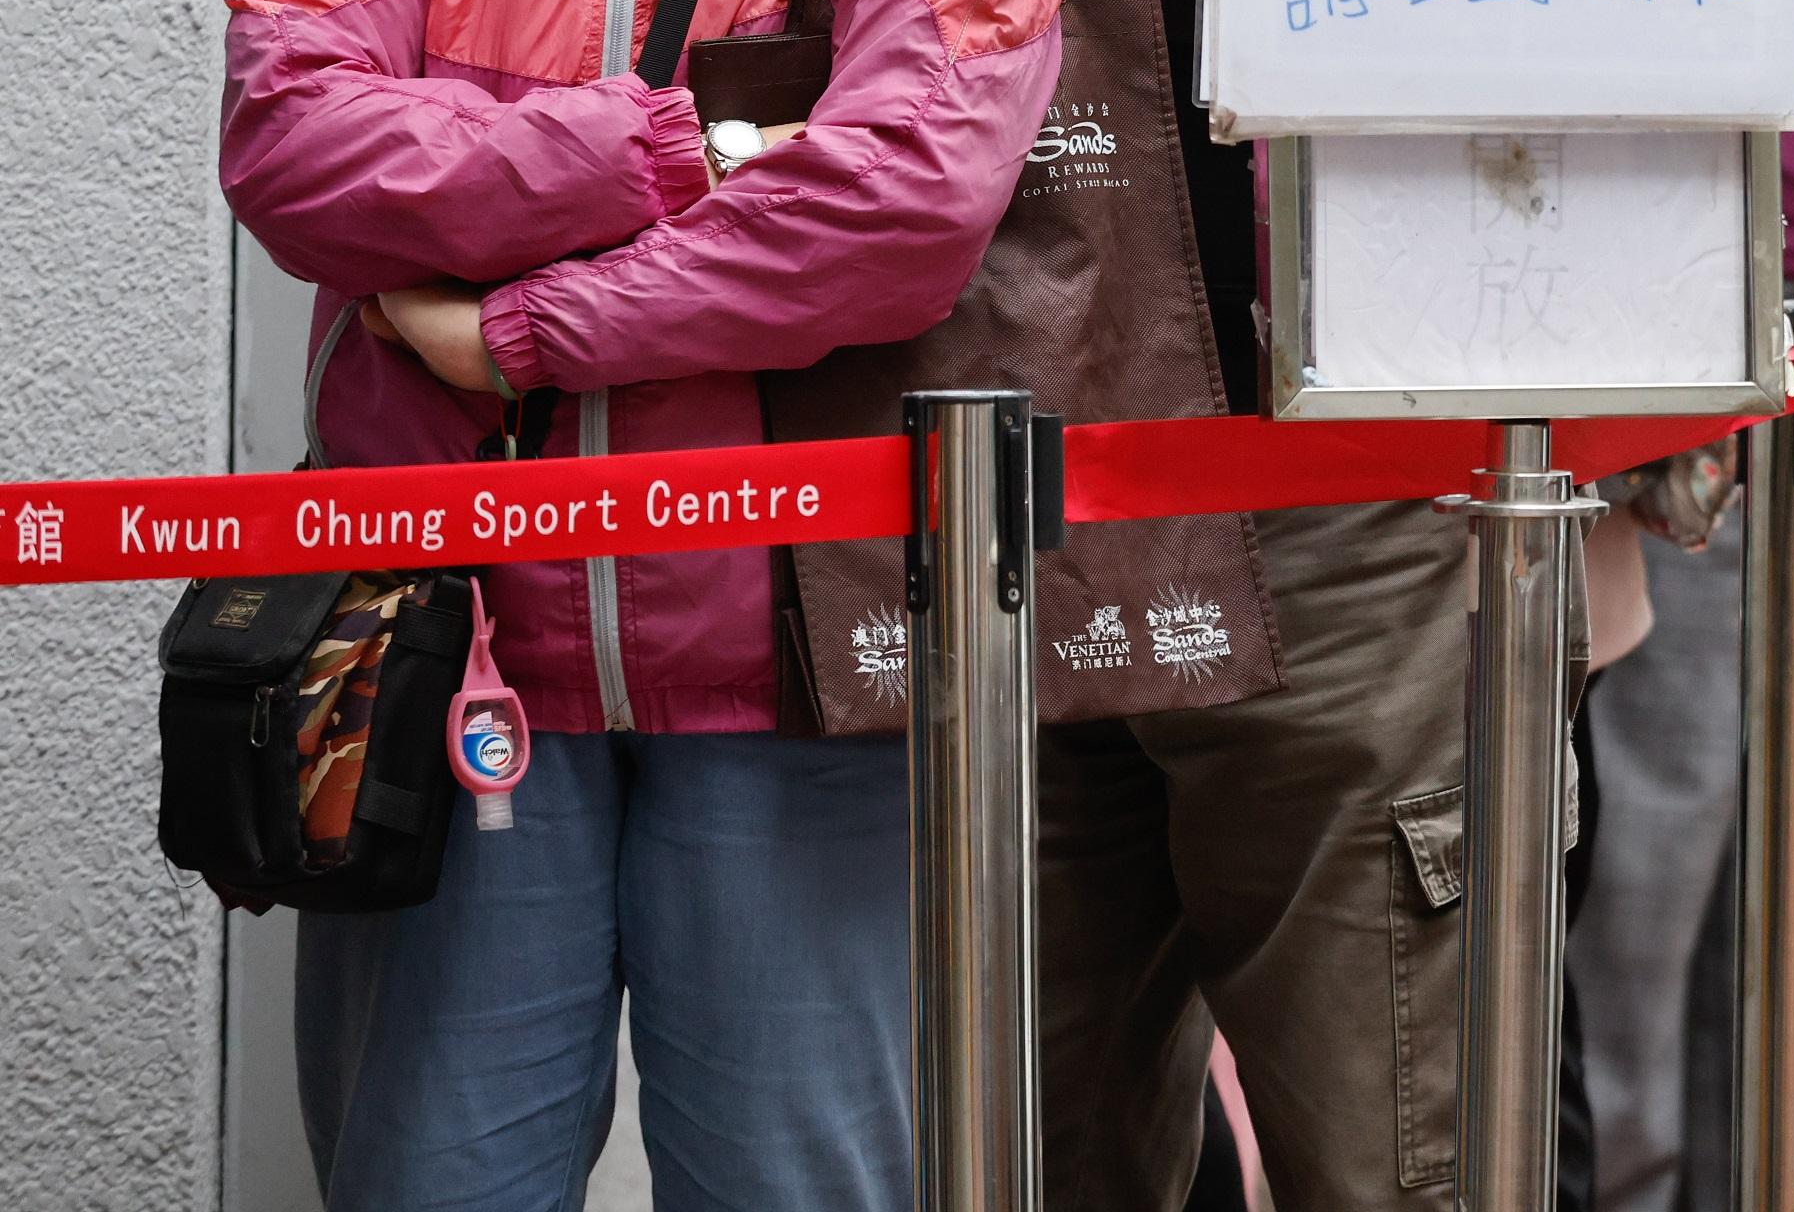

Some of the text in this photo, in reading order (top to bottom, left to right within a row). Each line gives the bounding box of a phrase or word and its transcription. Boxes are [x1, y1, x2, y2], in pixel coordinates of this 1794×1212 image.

[1025, 121, 1118, 164] Sands
[1047, 162, 1110, 179] REWARDS
[1022, 182, 1069, 199] COTAI
[0, 479, 821, 565] 館 Kwun Chung Sport Centre
[1071, 634, 1088, 643] THE
[1152, 623, 1228, 651] Sands
[1052, 641, 1131, 661] VENETIAN
[1154, 643, 1232, 664] Cotai Central
[482, 748, 509, 757] Walch
